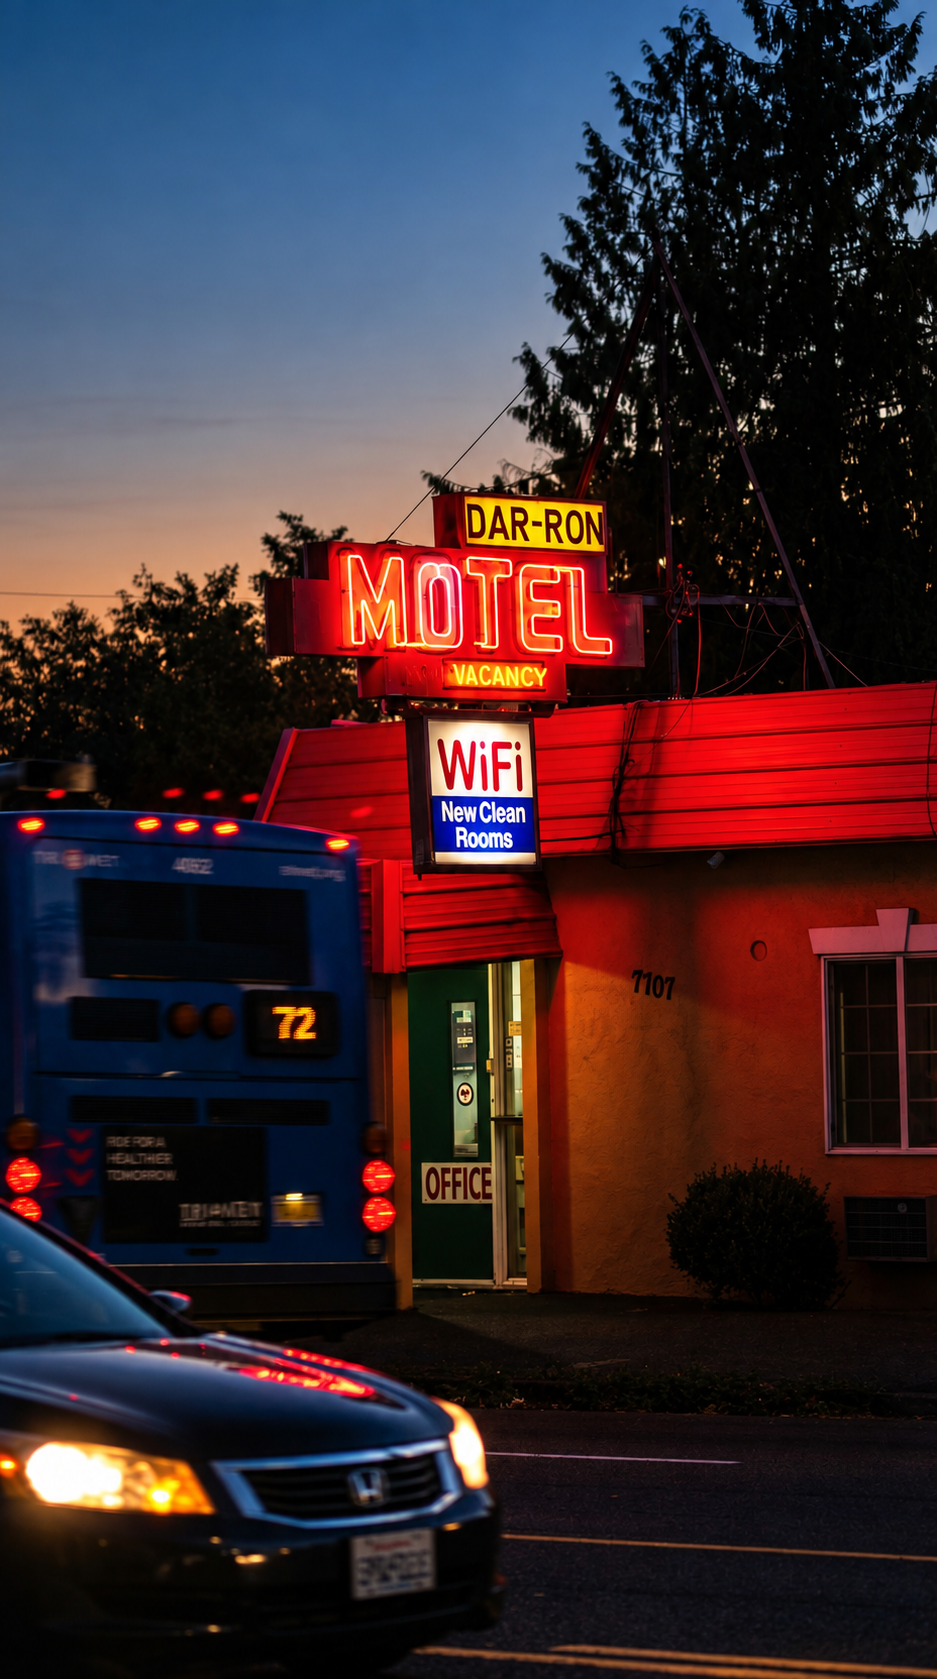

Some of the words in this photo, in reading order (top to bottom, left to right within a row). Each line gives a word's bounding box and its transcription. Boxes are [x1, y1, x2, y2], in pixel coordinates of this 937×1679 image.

[467, 503, 604, 546] DAR-RON
[344, 553, 613, 656] MOTEL
[452, 664, 548, 687] VACANCY
[437, 738, 524, 792] WiFi
[441, 801, 477, 823] New
[479, 801, 526, 824] Clean
[455, 827, 513, 849] Rooms
[631, 969, 675, 1000] 7107
[272, 1006, 316, 1039] 72
[106, 1152, 173, 1165] HEALTHIER
[425, 1166, 492, 1200] OFFICE
